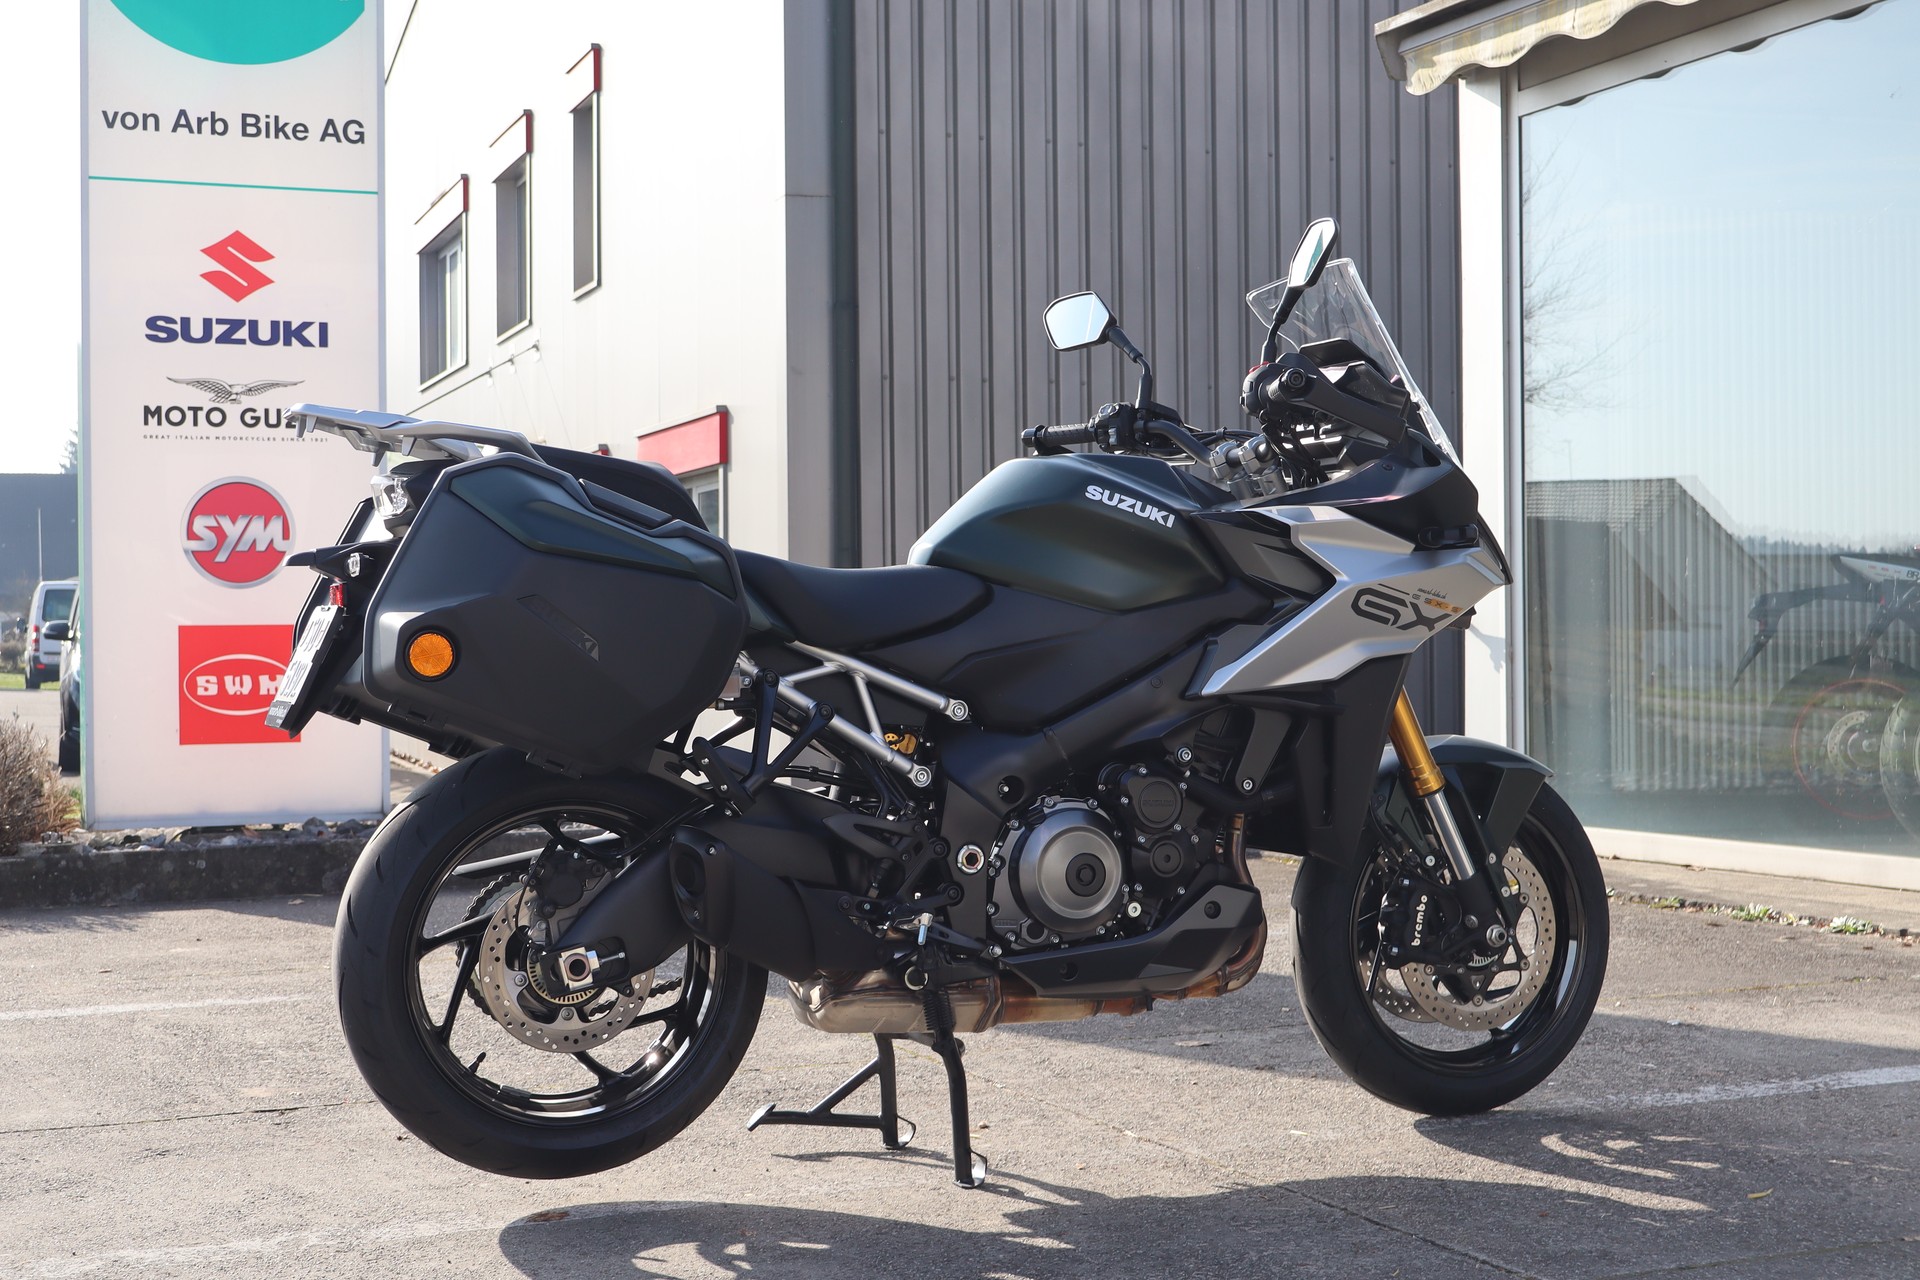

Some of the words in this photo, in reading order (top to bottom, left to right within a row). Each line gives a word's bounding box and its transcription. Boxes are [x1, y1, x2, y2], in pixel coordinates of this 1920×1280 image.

[102, 110, 160, 132] von
[171, 108, 229, 137] Arb
[241, 112, 310, 142] Bike
[319, 118, 365, 145] AG
[144, 315, 329, 348] SUZUKI
[143, 405, 227, 428] MOTO
[1085, 484, 1176, 529] SUZUKI
[183, 514, 290, 563] SYM
[1411, 894, 1428, 946] brembo
